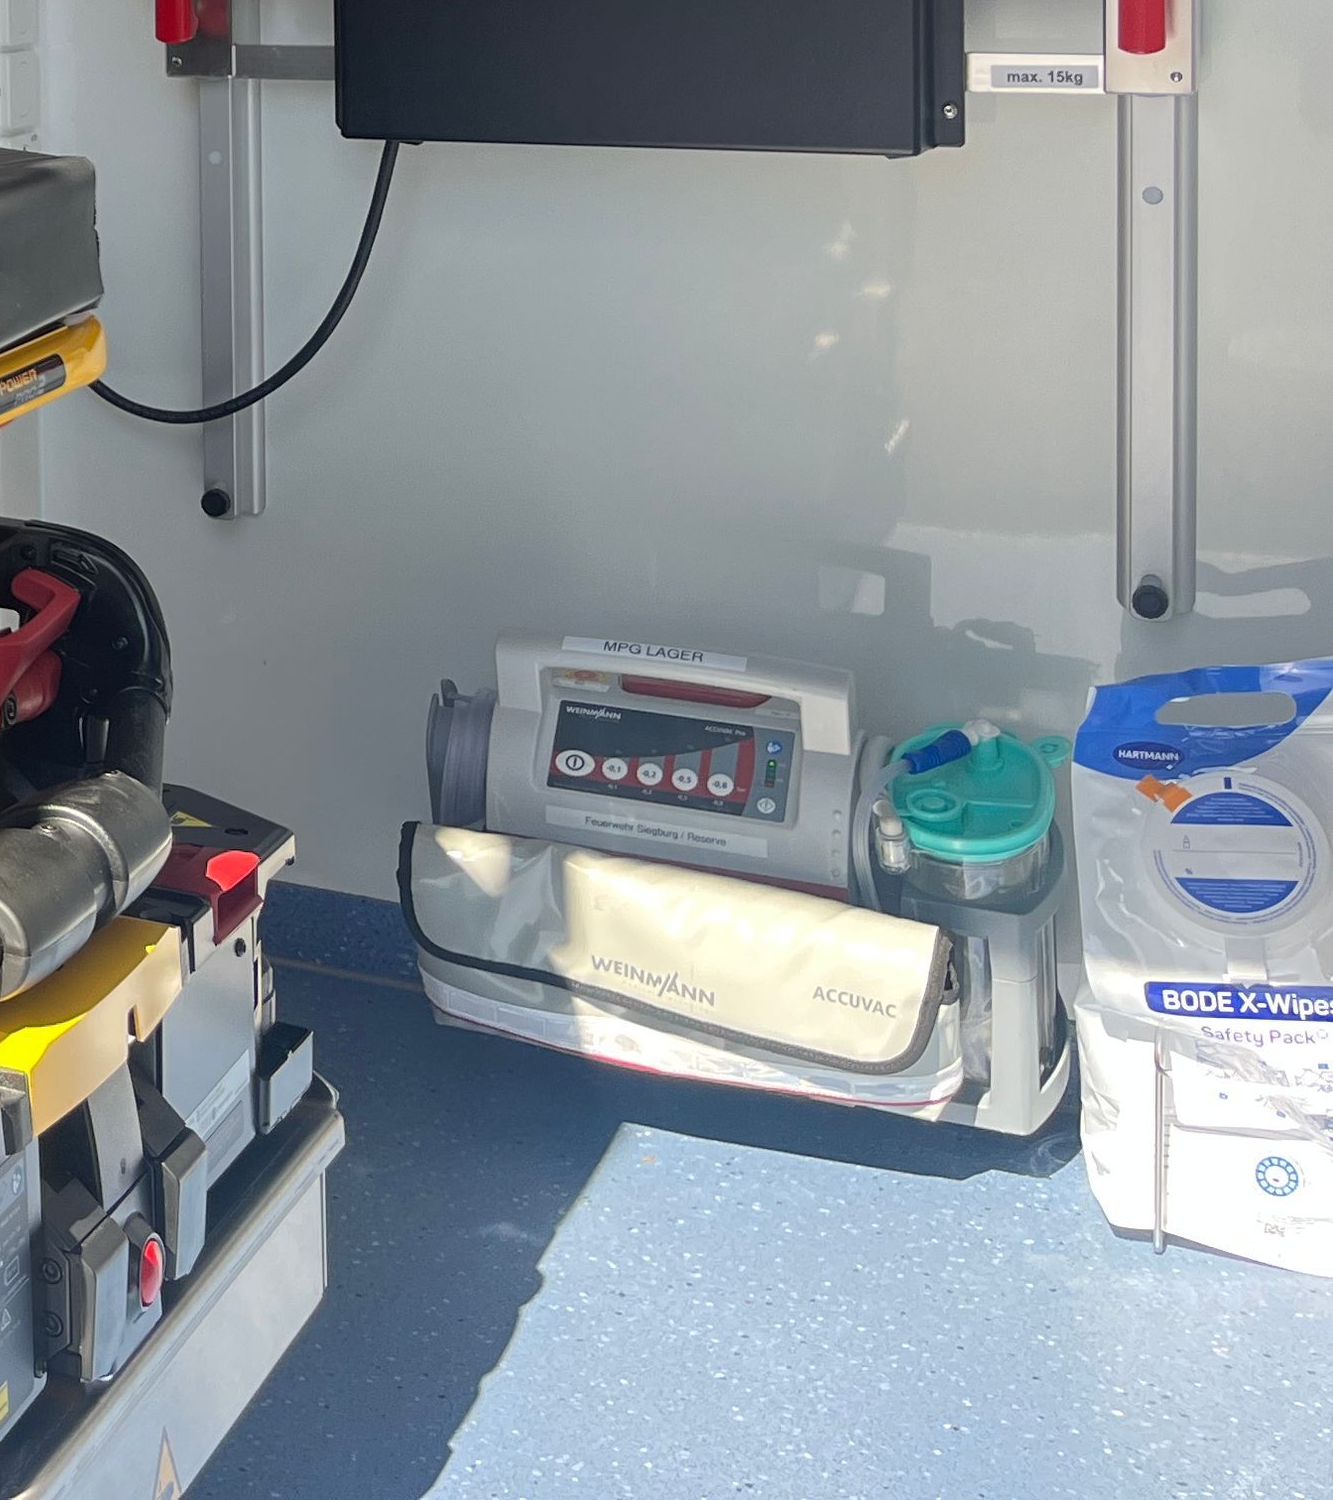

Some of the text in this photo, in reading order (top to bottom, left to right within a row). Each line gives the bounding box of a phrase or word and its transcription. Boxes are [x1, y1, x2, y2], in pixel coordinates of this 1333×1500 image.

[1007, 71, 1083, 86] max. 15kg
[604, 641, 704, 663] MPG LAGER
[566, 706, 621, 720] WEINMANN
[1119, 749, 1179, 762] HARTMANN
[585, 816, 634, 832] Feuerwehr
[637, 823, 679, 840] Siegburg
[687, 831, 727, 847] Reserve
[591, 955, 715, 1007] WEINMANN
[813, 986, 897, 1018] ACCUVAC
[1162, 989, 1234, 1013] BODE
[1201, 1026, 1316, 1048] Safety Pack
